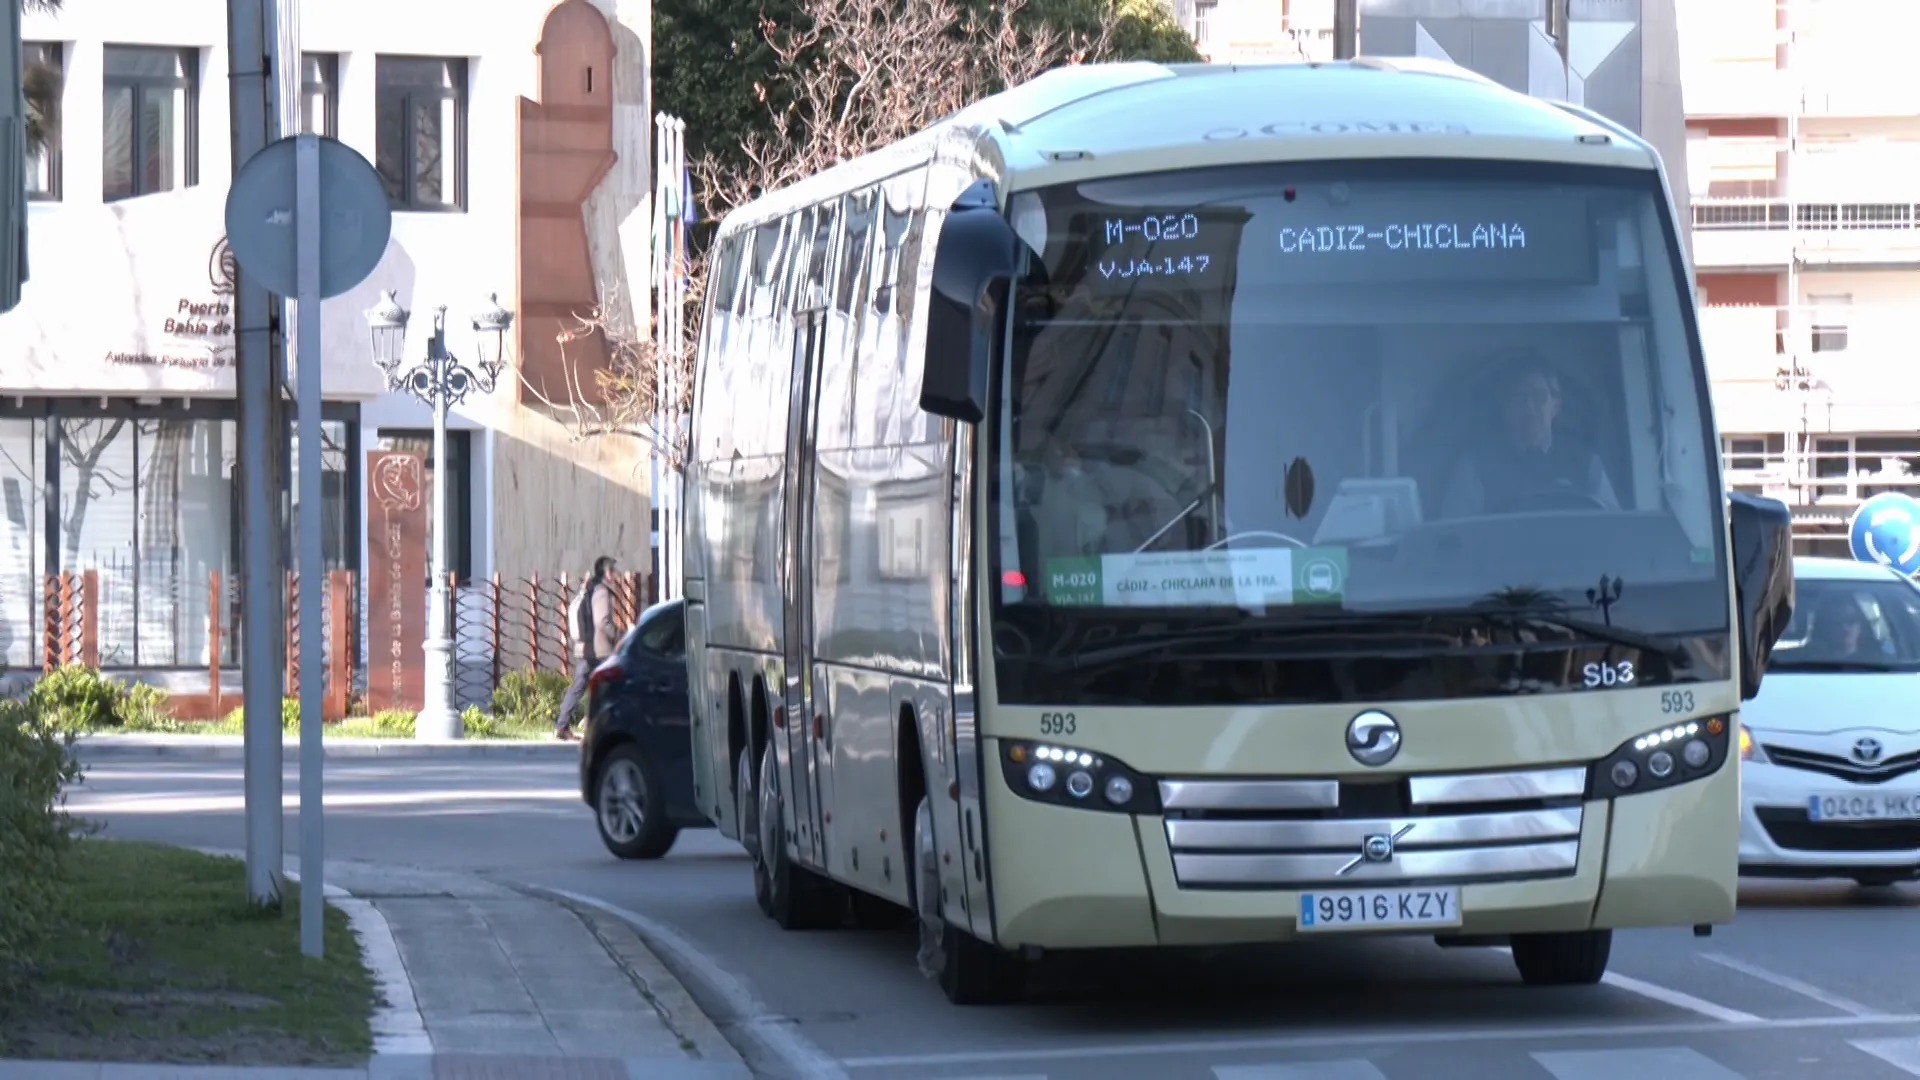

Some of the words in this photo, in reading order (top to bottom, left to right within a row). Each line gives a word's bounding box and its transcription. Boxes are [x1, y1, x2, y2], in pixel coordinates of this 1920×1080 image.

[1105, 213, 1199, 245] M-020
[1279, 223, 1526, 252] CADIZ-CHICLANA
[1099, 255, 1210, 280] VJA-147
[178, 298, 230, 316] Puerto
[164, 315, 209, 335] Bahía
[213, 320, 232, 336] de
[1053, 572, 1096, 588] M-020
[1161, 575, 1216, 592] CHICLANA
[1583, 661, 1635, 688] Sb3
[1661, 690, 1696, 713] 593
[1040, 711, 1077, 735] 593
[1318, 894, 1389, 922] 9916
[1398, 891, 1448, 919] KZY
